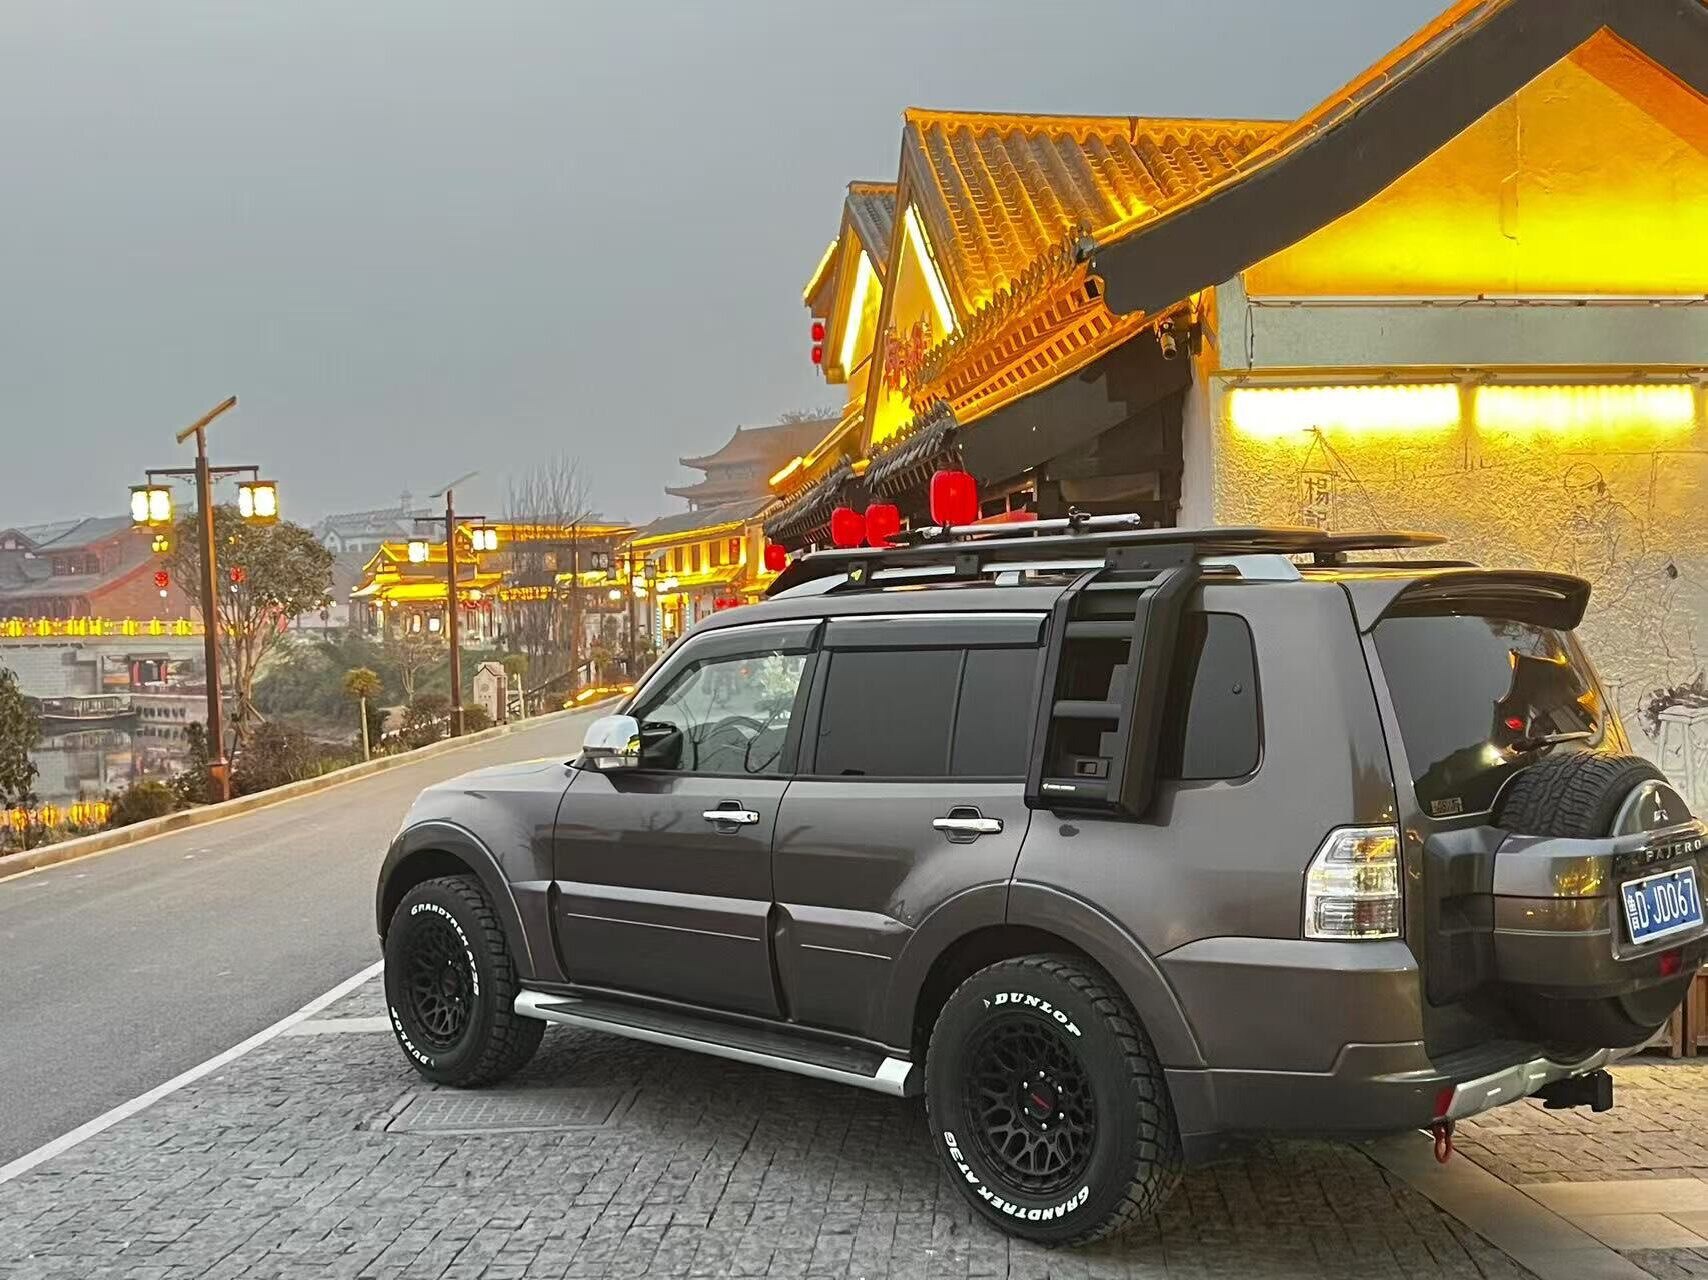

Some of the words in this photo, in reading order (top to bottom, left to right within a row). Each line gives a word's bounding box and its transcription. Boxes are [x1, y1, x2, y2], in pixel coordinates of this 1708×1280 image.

[1646, 839, 1702, 862] PAJERO
[411, 903, 469, 946] GRANDTREK
[391, 1006, 429, 1065] DUNLOP
[994, 992, 1082, 1037] DUNLOP
[943, 1131, 980, 1184] AT3G
[977, 1185, 1090, 1221] GRANDTREK
